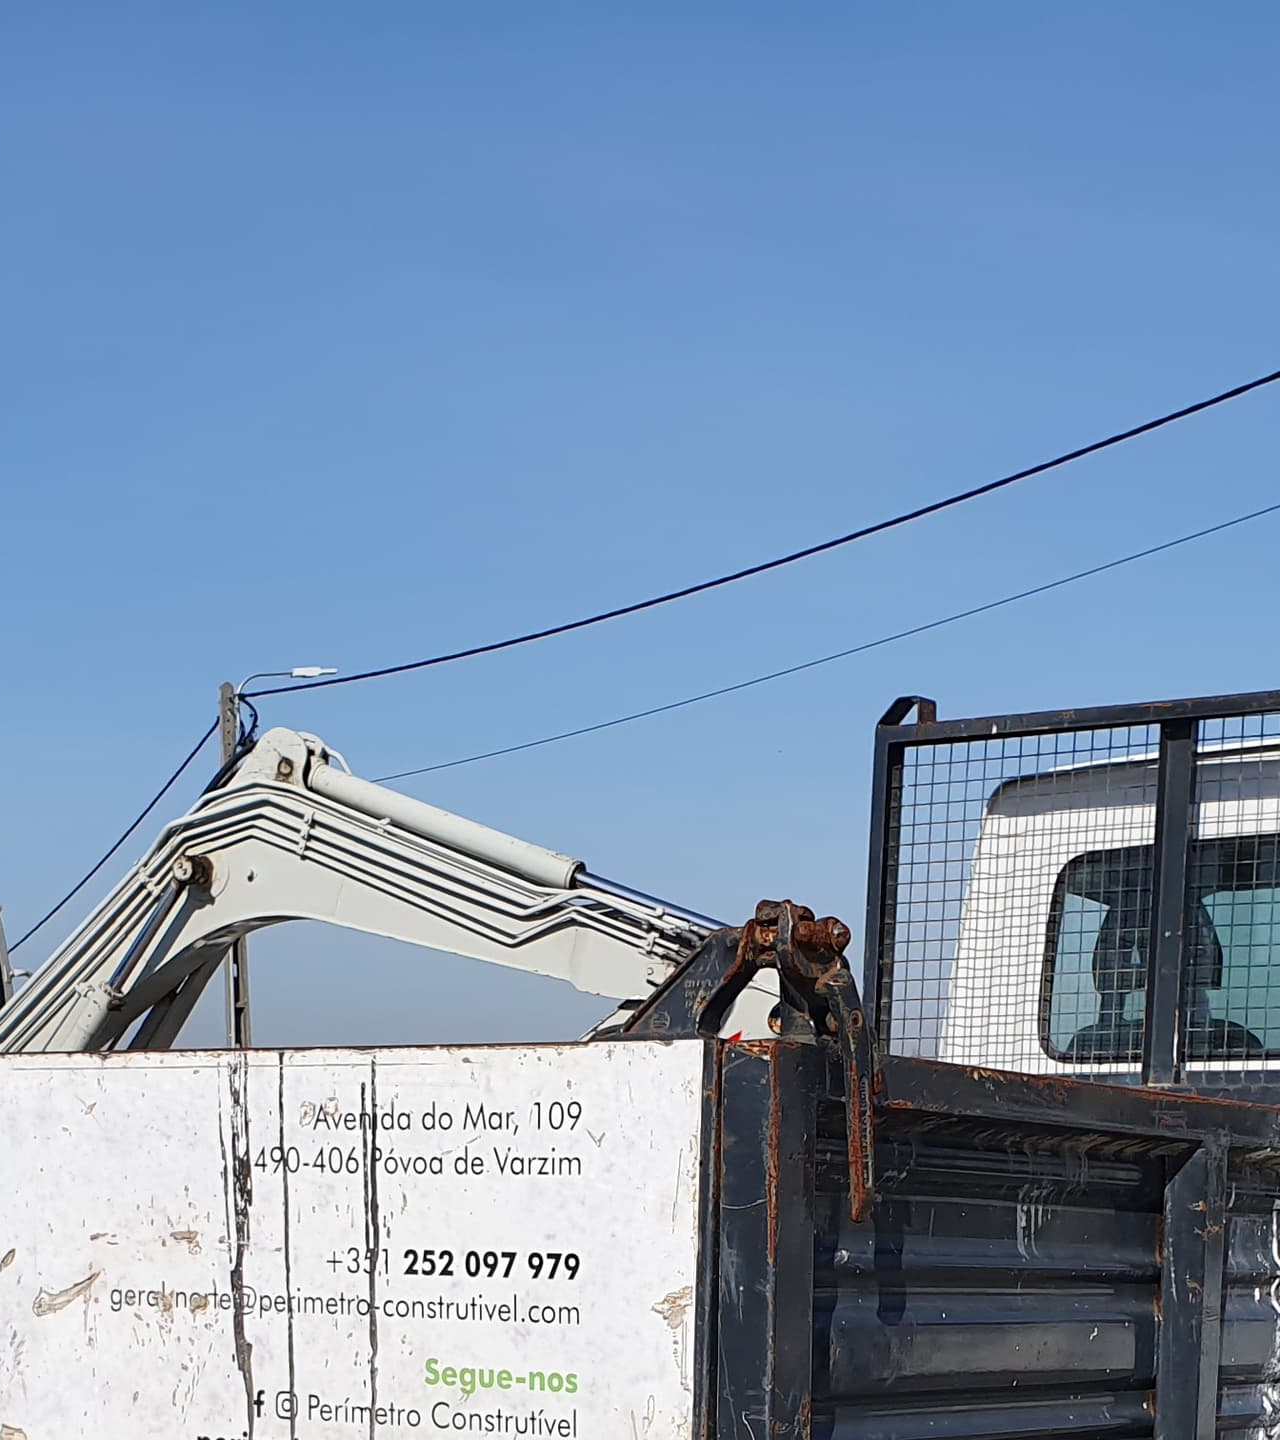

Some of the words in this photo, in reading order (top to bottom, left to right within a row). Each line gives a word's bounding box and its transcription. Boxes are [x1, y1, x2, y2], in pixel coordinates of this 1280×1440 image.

[313, 1098, 411, 1130] Avenida
[422, 1101, 454, 1130] do
[463, 1102, 520, 1136] Mar,
[534, 1102, 582, 1130] 109
[240, 1146, 360, 1175] 490-406
[372, 1147, 443, 1176] Póvoa
[454, 1147, 485, 1176] de
[493, 1147, 582, 1176] Varzim
[403, 1249, 455, 1277] 252
[465, 1250, 516, 1279] 097
[527, 1252, 581, 1281] 979
[424, 1357, 578, 1394] Segue-nos
[308, 1394, 422, 1429] Perímetro
[431, 1401, 578, 1439] Construtível
